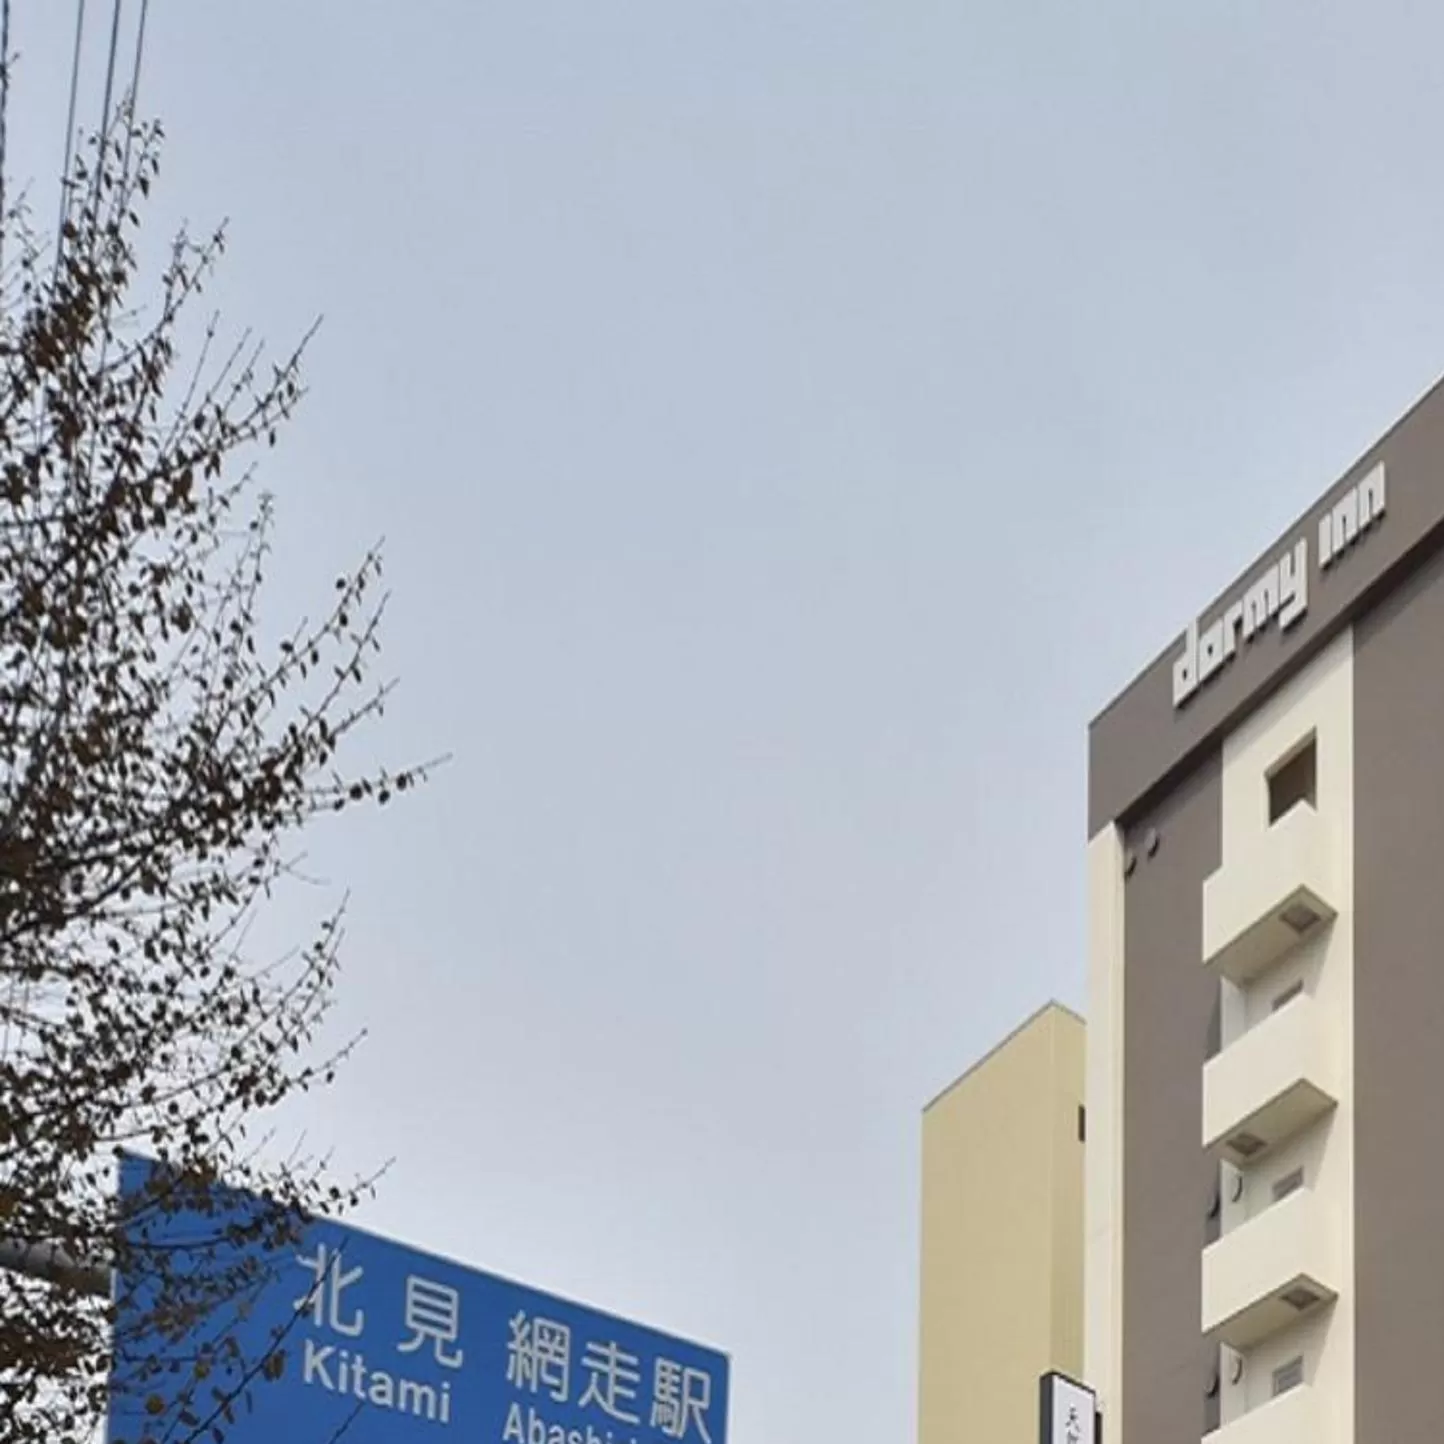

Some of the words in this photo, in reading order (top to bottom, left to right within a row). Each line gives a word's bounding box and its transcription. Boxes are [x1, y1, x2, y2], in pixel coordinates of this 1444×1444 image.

[1172, 536, 1309, 708] dormy
[1318, 459, 1386, 569] inn
[292, 1242, 465, 1369] 北見
[303, 1338, 451, 1424] Kitami
